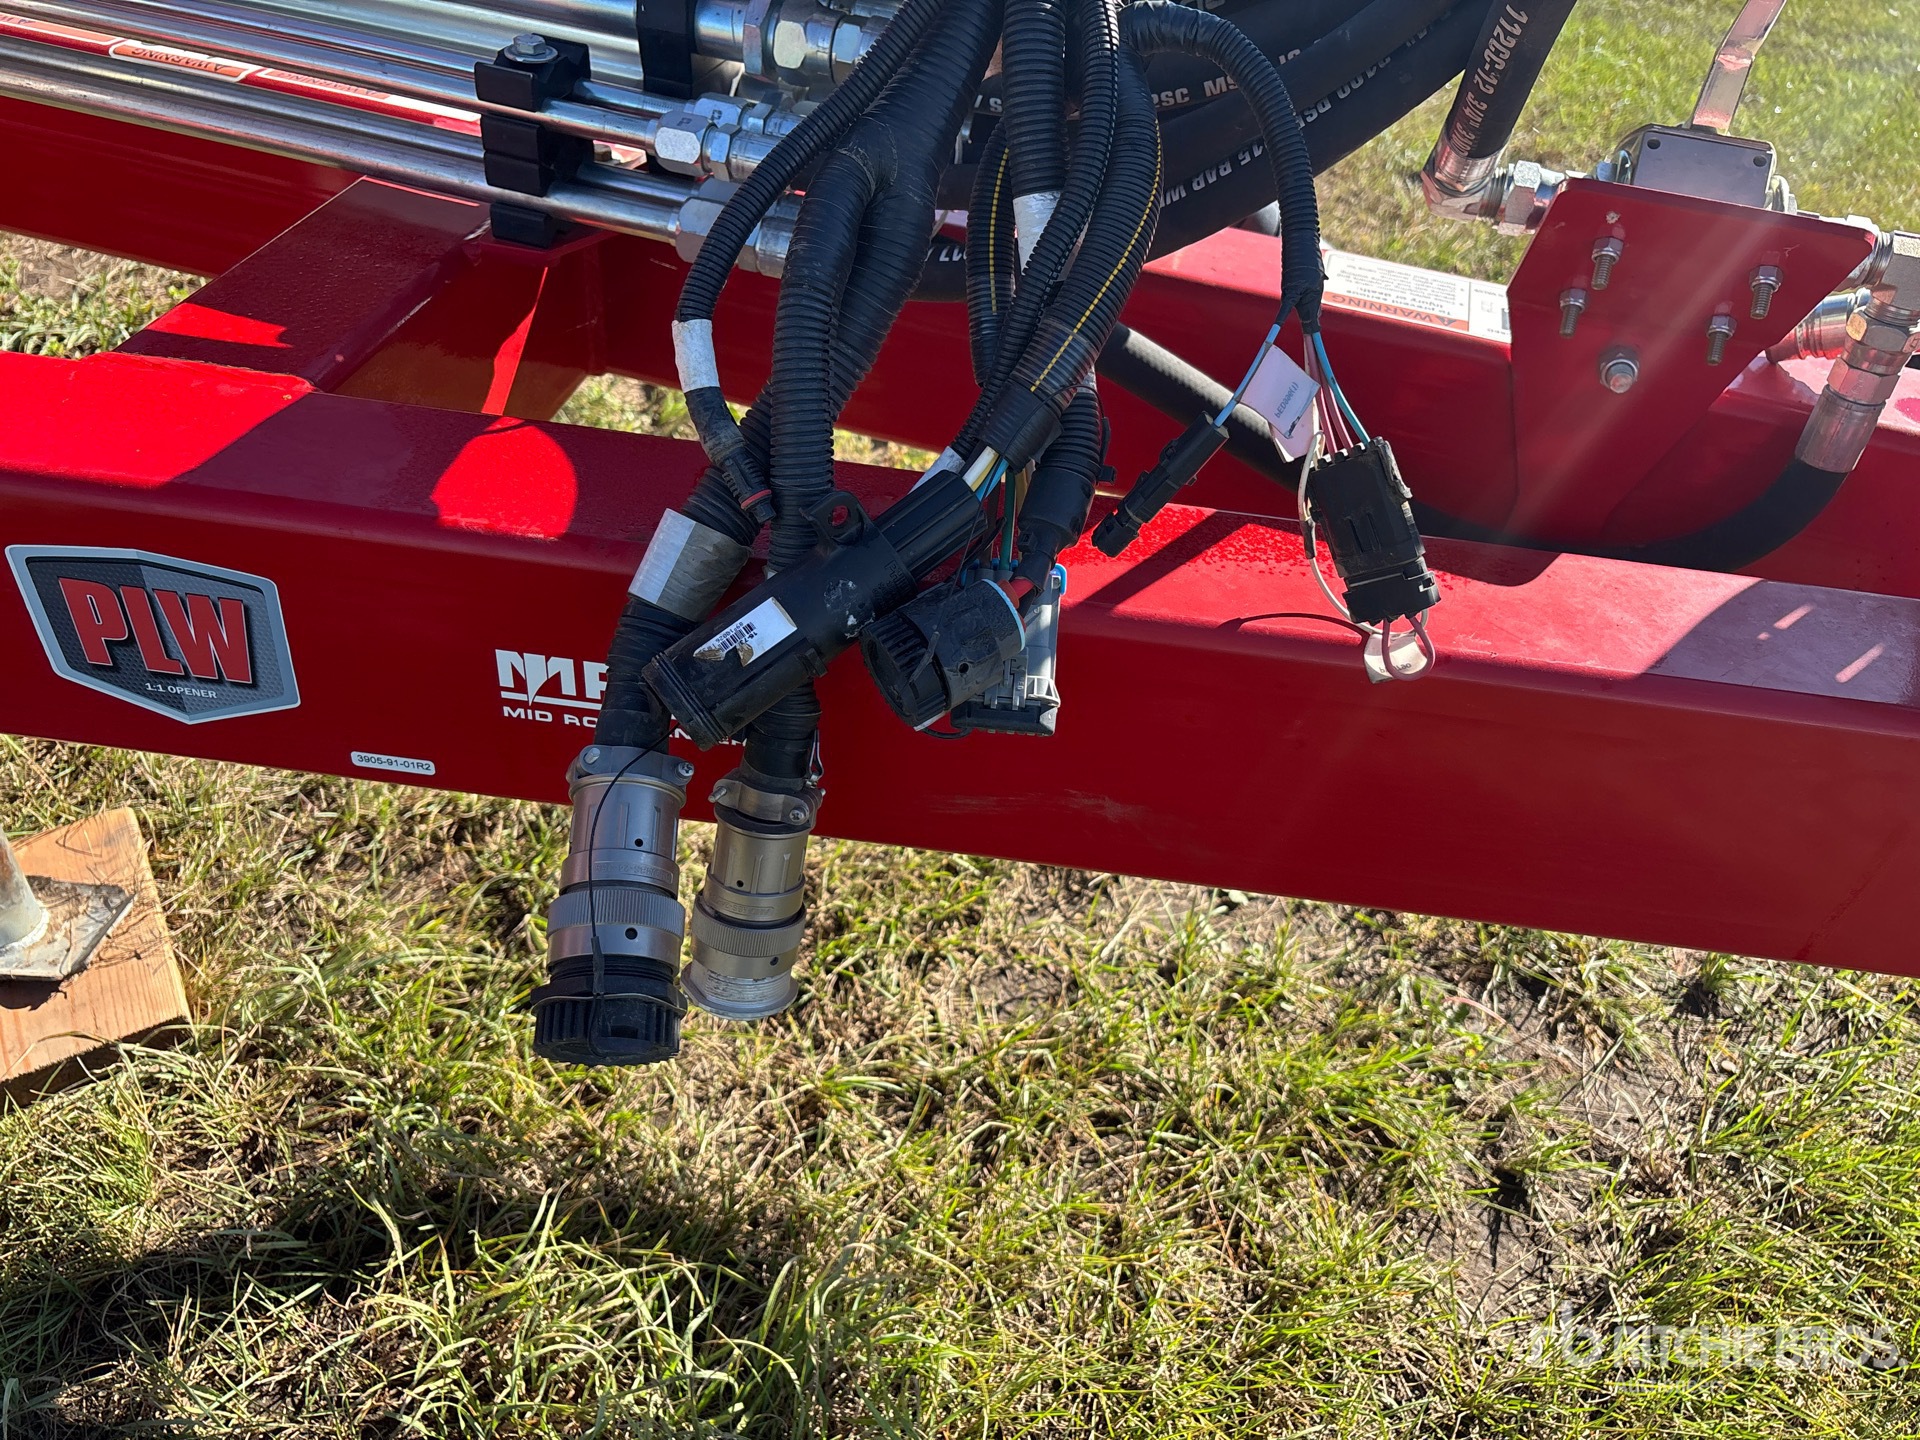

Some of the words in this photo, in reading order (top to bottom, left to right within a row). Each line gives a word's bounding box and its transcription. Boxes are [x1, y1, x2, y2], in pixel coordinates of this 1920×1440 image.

[1331, 294, 1433, 323] WARNING
[58, 577, 253, 684] PLW
[167, 685, 218, 699] OPENER
[503, 706, 553, 722] MID
[356, 753, 432, 772] 3905-91-01R2
